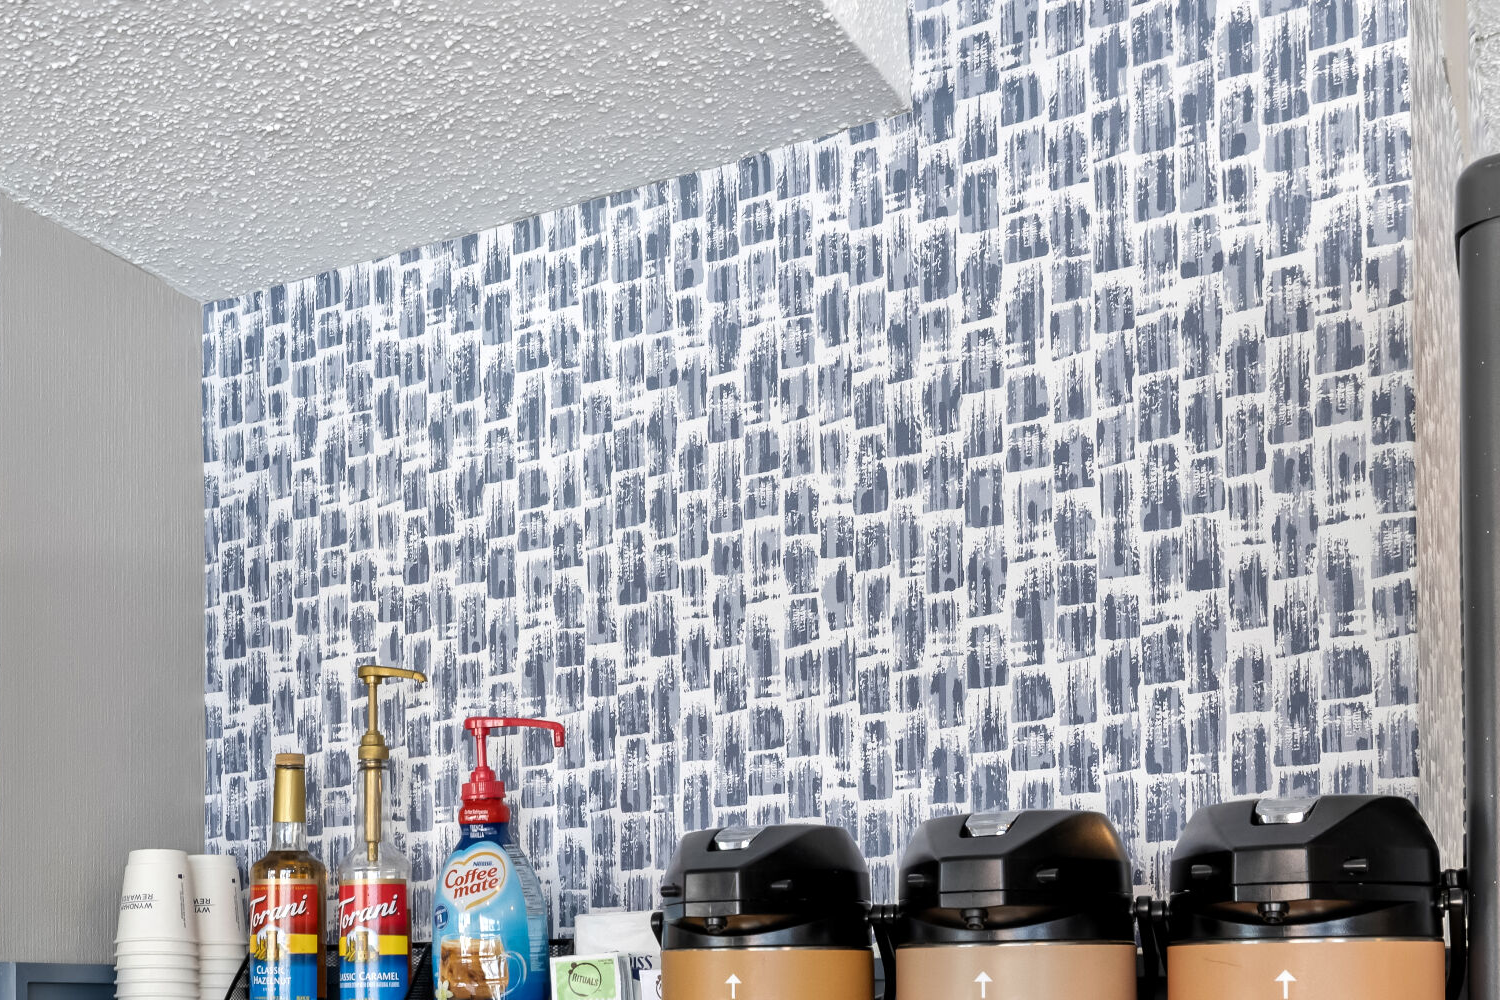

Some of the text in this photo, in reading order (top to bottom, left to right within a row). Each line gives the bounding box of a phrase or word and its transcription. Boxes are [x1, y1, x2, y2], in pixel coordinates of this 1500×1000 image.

[445, 867, 498, 889] Coffee
[453, 877, 500, 899] mate
[250, 894, 308, 935] Torani
[339, 894, 398, 937] Torani
[256, 965, 285, 975] CLASSIC
[340, 971, 400, 982] ASSIC CARAMEL
[253, 976, 291, 985] HAZELNUT
[572, 972, 600, 987] RITUALS
